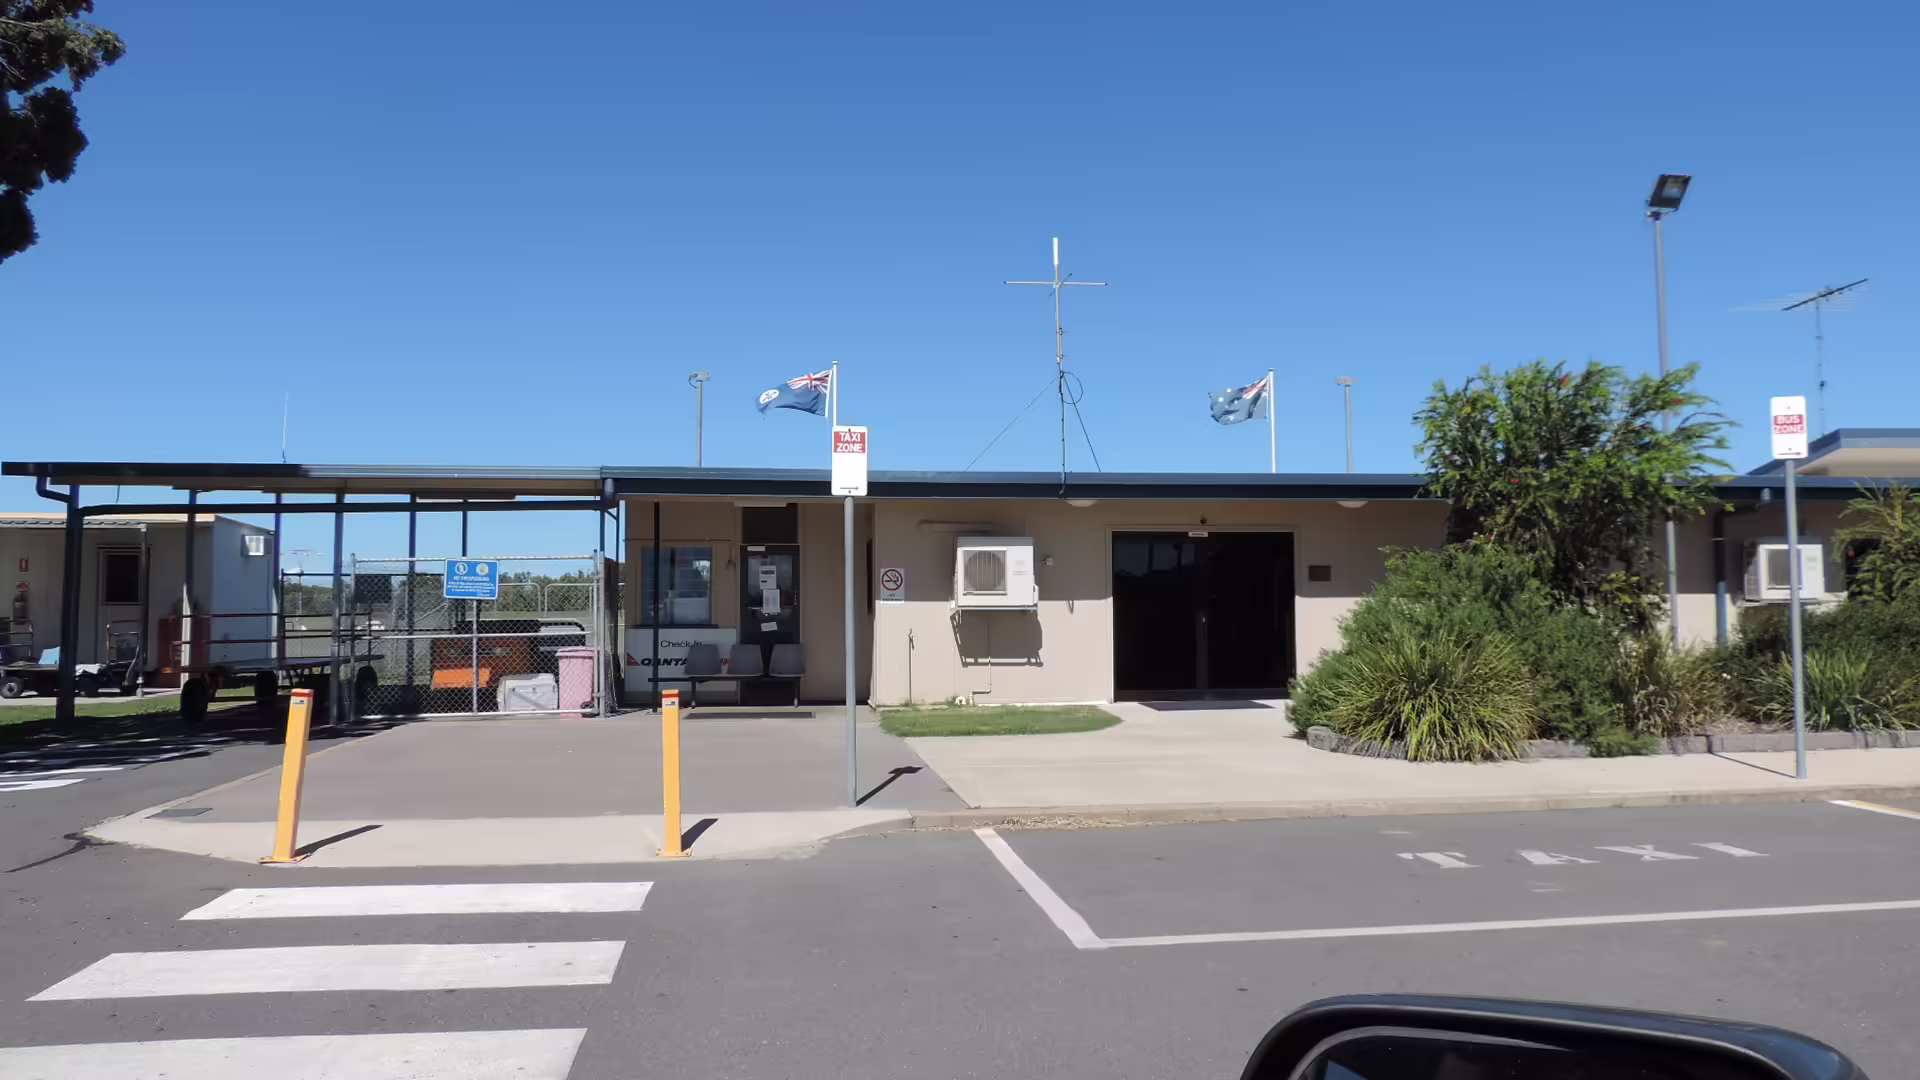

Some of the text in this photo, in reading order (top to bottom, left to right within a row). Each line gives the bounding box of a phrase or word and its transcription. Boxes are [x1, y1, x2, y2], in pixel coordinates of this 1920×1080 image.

[1777, 415, 1800, 424] BUS
[1774, 425, 1804, 433] ZONE
[839, 432, 861, 442] TAXI
[836, 443, 863, 452] ZONE
[1395, 842, 1770, 868] TAXI
